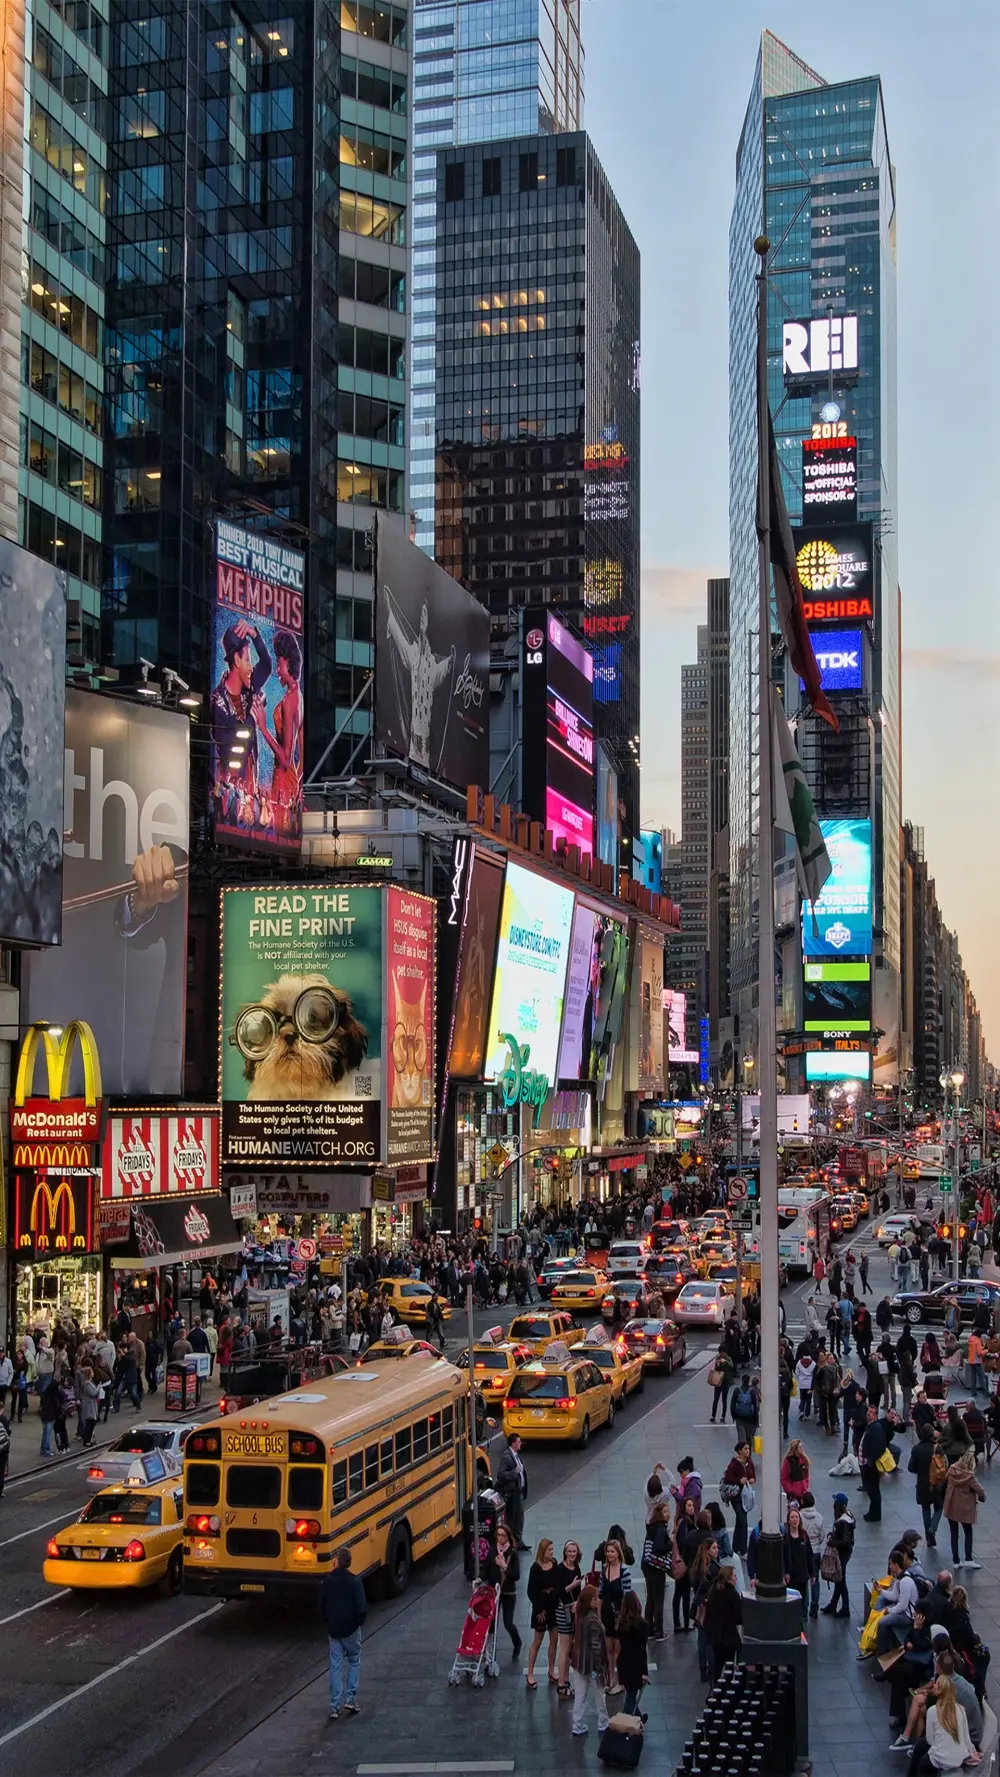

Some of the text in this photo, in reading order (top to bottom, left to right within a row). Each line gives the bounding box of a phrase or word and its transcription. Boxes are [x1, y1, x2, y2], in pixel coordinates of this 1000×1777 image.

[783, 316, 857, 374] REI
[812, 422, 848, 439] 2012
[803, 436, 856, 450] TOSHIBA
[803, 462, 855, 476] TOSHIBA
[814, 476, 855, 488] OFFICIAL
[804, 491, 846, 503] SPONSOR
[218, 520, 304, 572] WINNER! 2010 TONY AWARD
[218, 537, 249, 566] BEST
[252, 552, 303, 589] MUSICAL
[824, 552, 854, 565] TIMES
[829, 561, 868, 574] SQUARE
[812, 572, 856, 590] 2012
[218, 565, 303, 629] MEMPHIS
[803, 598, 872, 619] OSHIBA
[526, 651, 543, 664] LG
[816, 651, 859, 669] TDK
[63, 746, 188, 864] the
[359, 857, 391, 866] LAMAR
[254, 894, 350, 914] READ THE
[400, 899, 422, 919] Don't let
[249, 917, 356, 937] FINE PRINT
[393, 918, 428, 941] HSUS disguise
[249, 941, 262, 949] The
[293, 940, 319, 950] Society
[319, 940, 327, 948] of
[328, 940, 341, 948] the
[341, 939, 357, 948] U.S.
[393, 940, 407, 955] itself
[416, 944, 428, 961] local
[257, 951, 347, 961] is NOT affiliated with your
[274, 962, 330, 972] local pet shelter.
[396, 963, 407, 979] pet
[498, 1032, 550, 1130] Disney
[239, 1104, 364, 1114] The Humane Society of the United
[13, 1112, 97, 1126] McDonald's
[239, 1115, 364, 1126] States only gives 1% of its budget
[27, 1129, 83, 1137] Restaurant
[273, 1126, 291, 1134] local
[292, 1127, 306, 1136] pet
[306, 1126, 338, 1135] shelters.
[228, 1141, 375, 1155] HUMANEWATCH.ORG
[258, 1192, 330, 1202] COMPUTERS
[227, 1436, 283, 1454] SCHOOL BUS
[252, 1512, 258, 1525] 6
